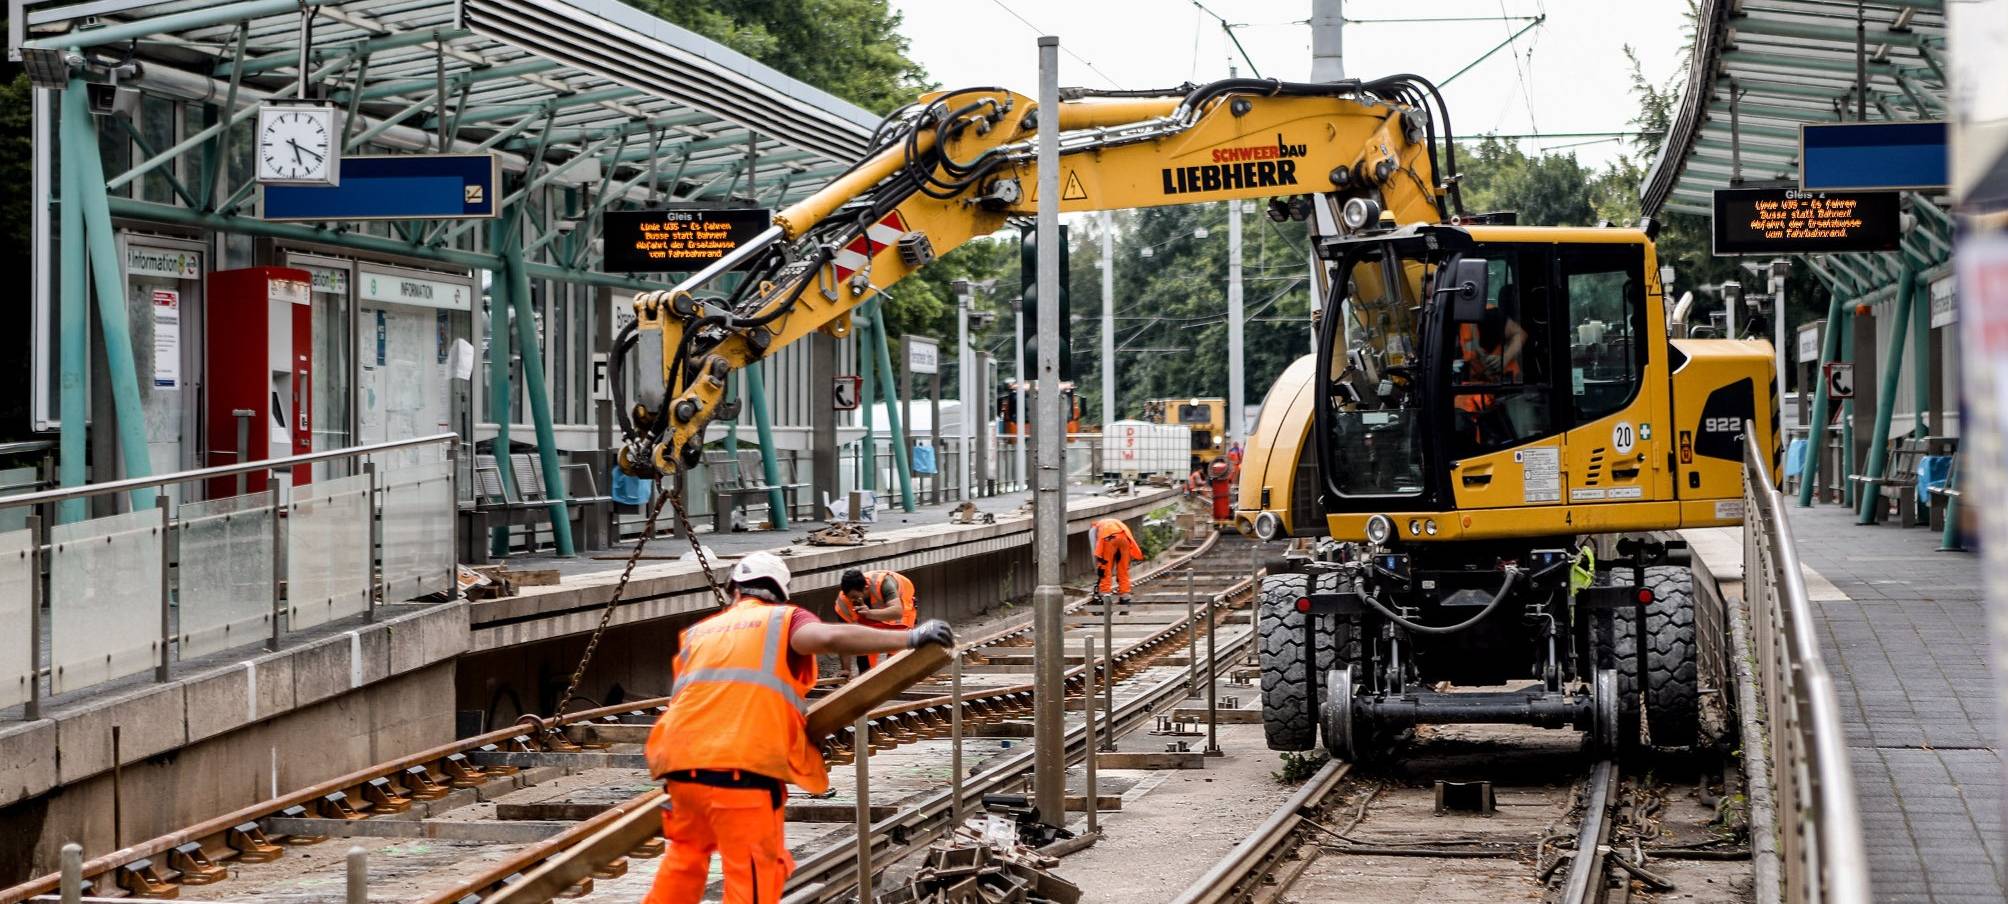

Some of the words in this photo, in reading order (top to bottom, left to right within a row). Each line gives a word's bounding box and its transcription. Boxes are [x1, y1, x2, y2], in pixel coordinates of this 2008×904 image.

[1162, 160, 1298, 194] LIEBHERR
[667, 212, 693, 221] Gleis
[697, 212, 702, 220] 1
[1760, 210, 1787, 219] Busse
[1791, 210, 1814, 219] statt
[645, 232, 669, 240] Busse
[673, 232, 693, 240] statt
[132, 251, 177, 272] Information
[400, 282, 433, 299] INFORMATION
[594, 361, 607, 393] F
[1705, 417, 1741, 432] 922
[1616, 426, 1631, 447] 20
[1566, 510, 1572, 526] 4
